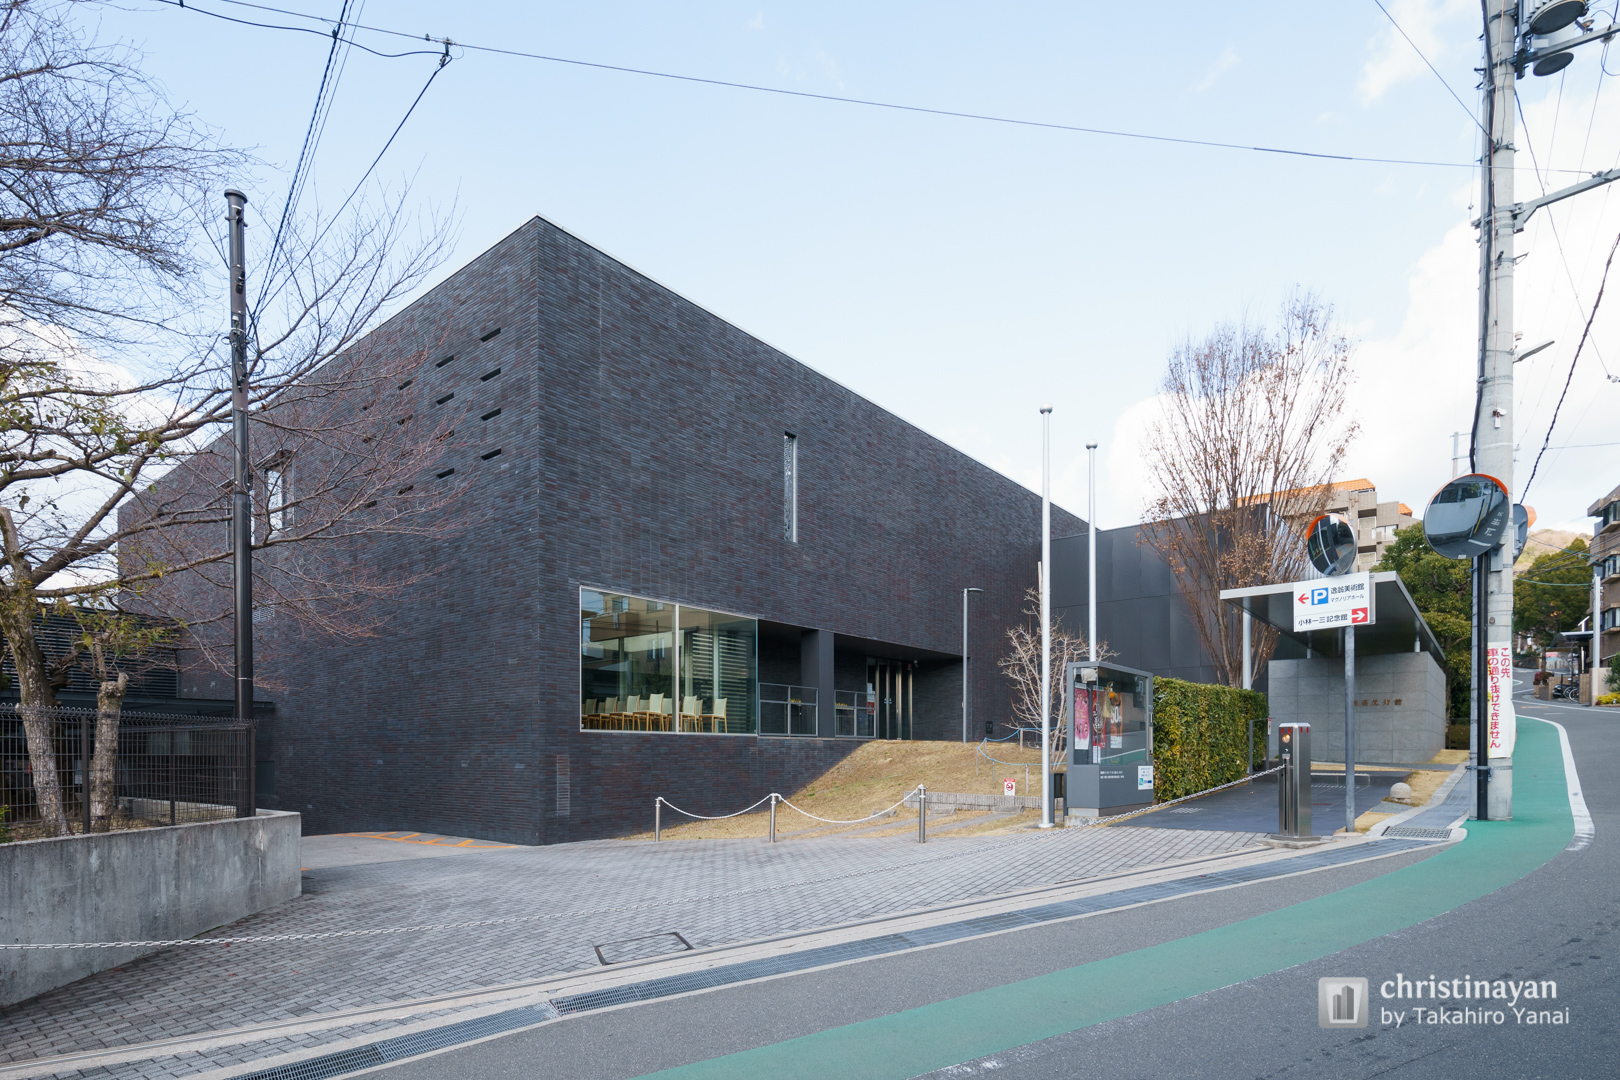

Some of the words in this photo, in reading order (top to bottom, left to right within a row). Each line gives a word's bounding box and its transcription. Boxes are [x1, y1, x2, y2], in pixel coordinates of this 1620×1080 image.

[1313, 589, 1327, 604] P
[1298, 614, 1348, 626] 小林一三記念館
[1500, 647, 1510, 678] この先
[1487, 648, 1500, 748] 車の通り抜けできません
